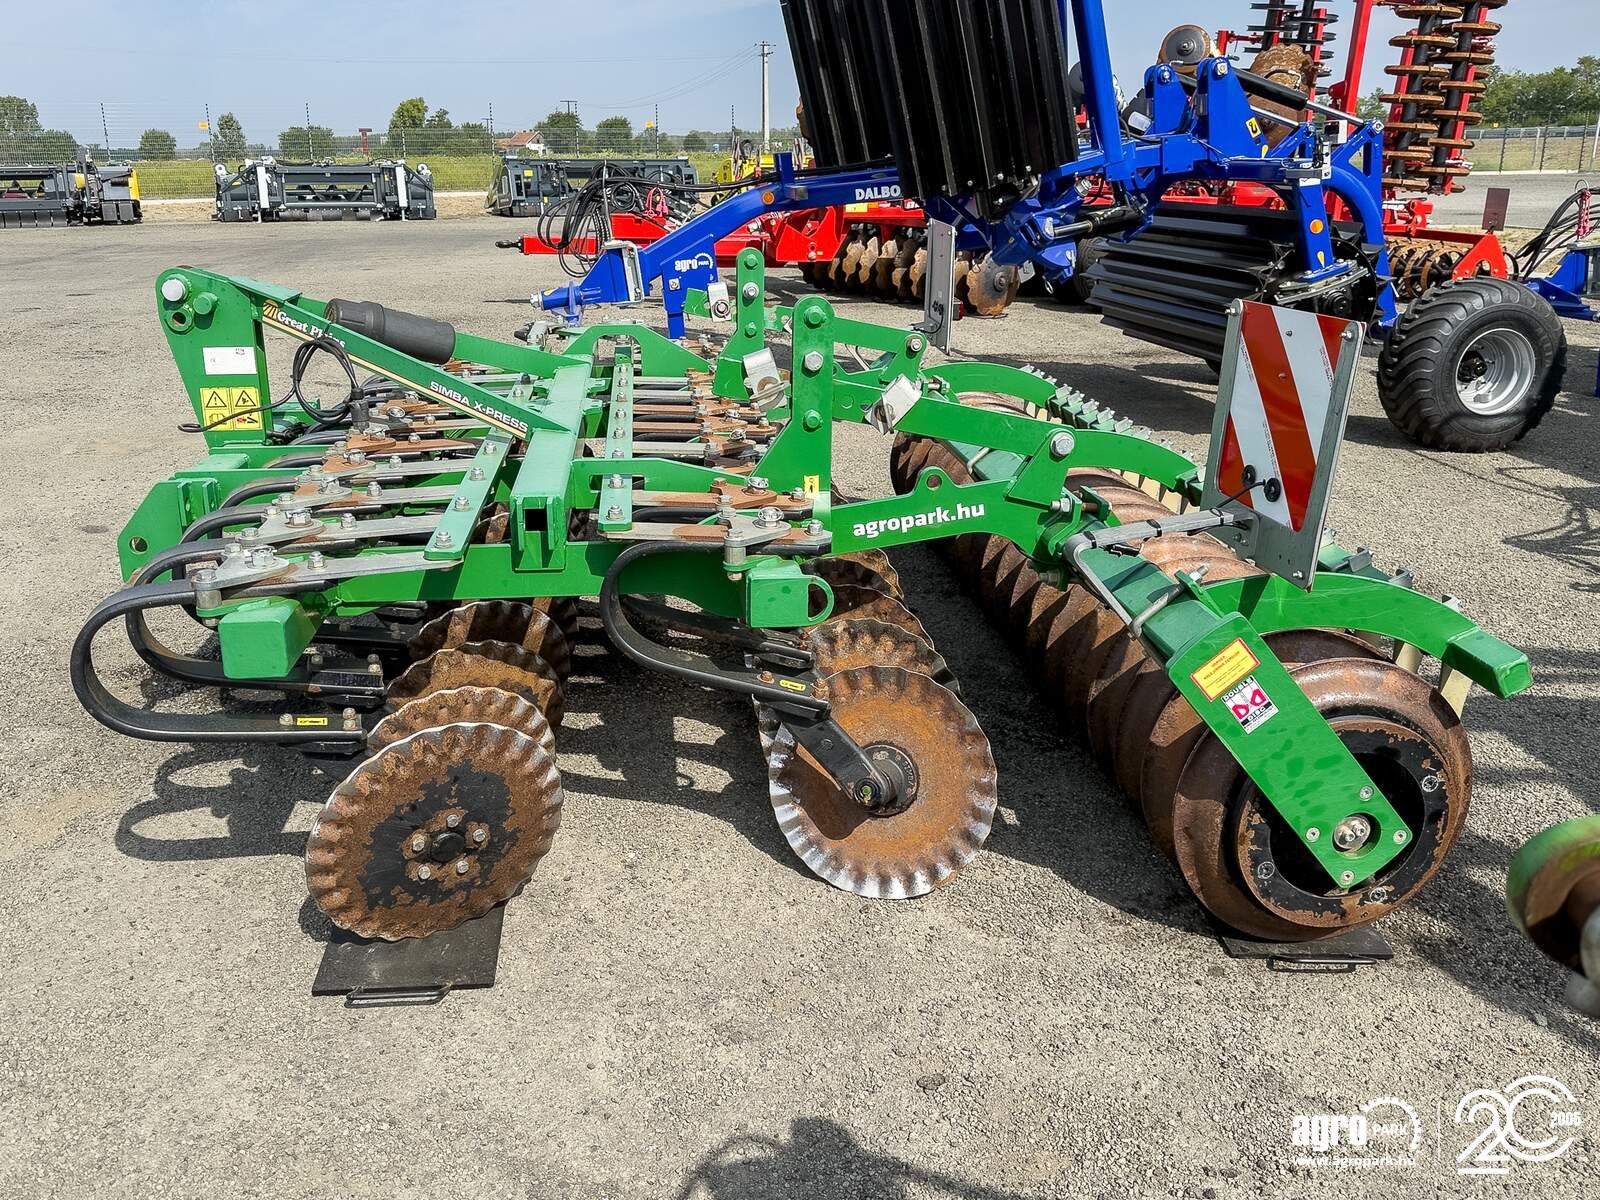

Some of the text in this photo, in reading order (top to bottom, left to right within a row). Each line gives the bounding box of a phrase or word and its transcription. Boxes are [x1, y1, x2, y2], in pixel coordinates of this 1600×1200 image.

[855, 184, 901, 201] DALBO
[674, 258, 698, 272] agro
[277, 311, 308, 333] Great
[430, 381, 529, 433] SIMBA X-PRESS
[853, 503, 985, 538] agropark.hu
